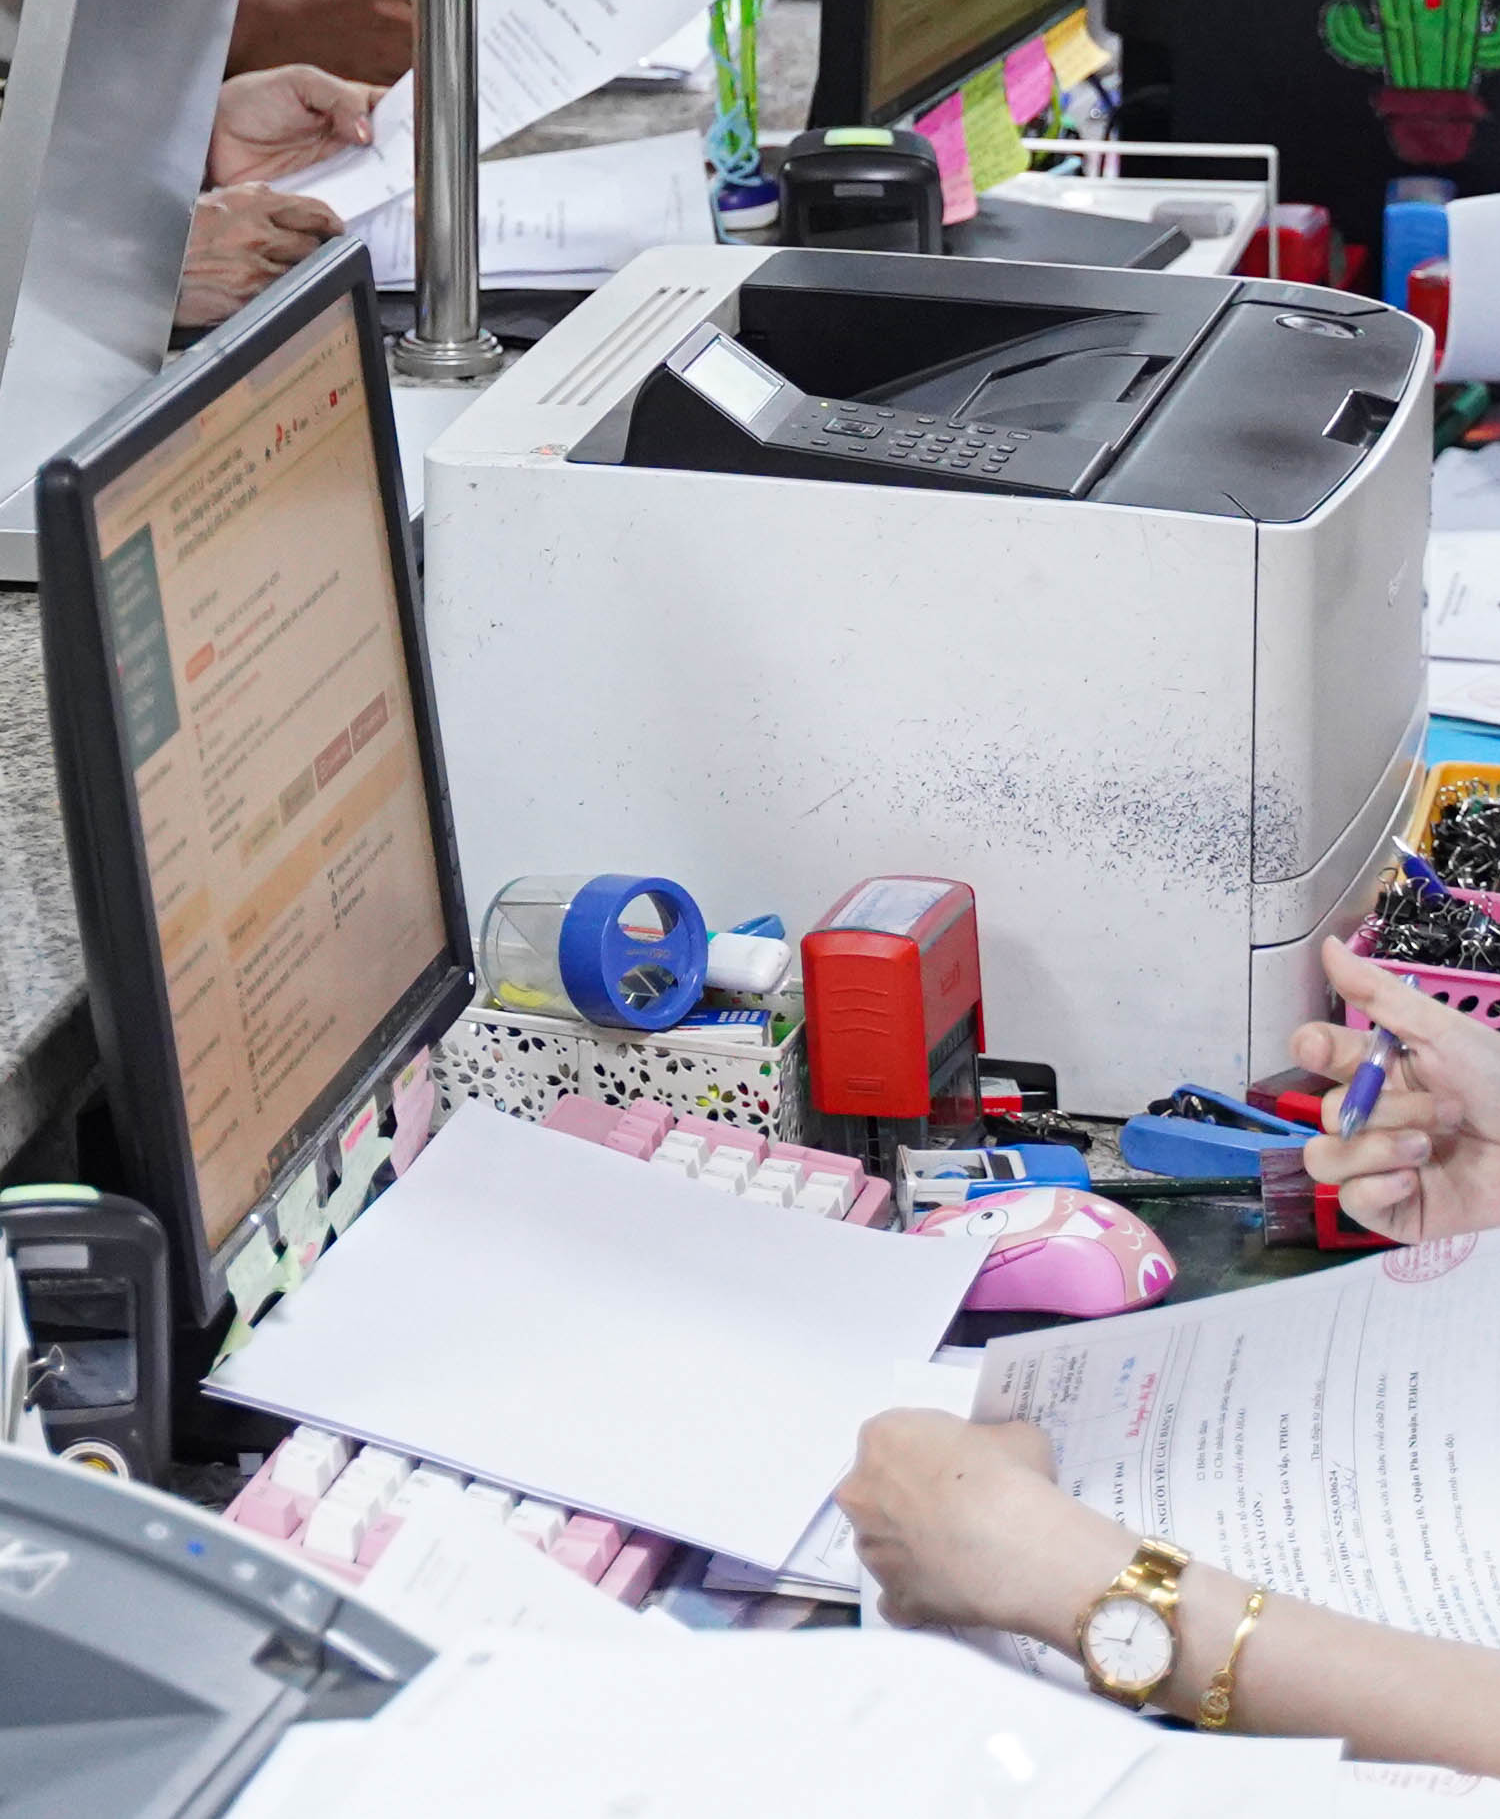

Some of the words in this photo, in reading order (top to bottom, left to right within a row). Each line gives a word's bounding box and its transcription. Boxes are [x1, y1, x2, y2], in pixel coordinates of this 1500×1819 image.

[1407, 1371, 1419, 1411] TP.HCM
[1278, 1412, 1289, 1451] TPHCM
[1407, 1412, 1418, 1448] Nhuận,
[1278, 1454, 1290, 1477] Vấp,
[1409, 1451, 1418, 1471] Phú
[1154, 1484, 1169, 1525] NGƯỜI
[1411, 1474, 1423, 1503] Quận
[1254, 1500, 1266, 1527] GÒN
[1282, 1497, 1295, 1526] Quận
[1418, 1523, 1433, 1561] Phường
